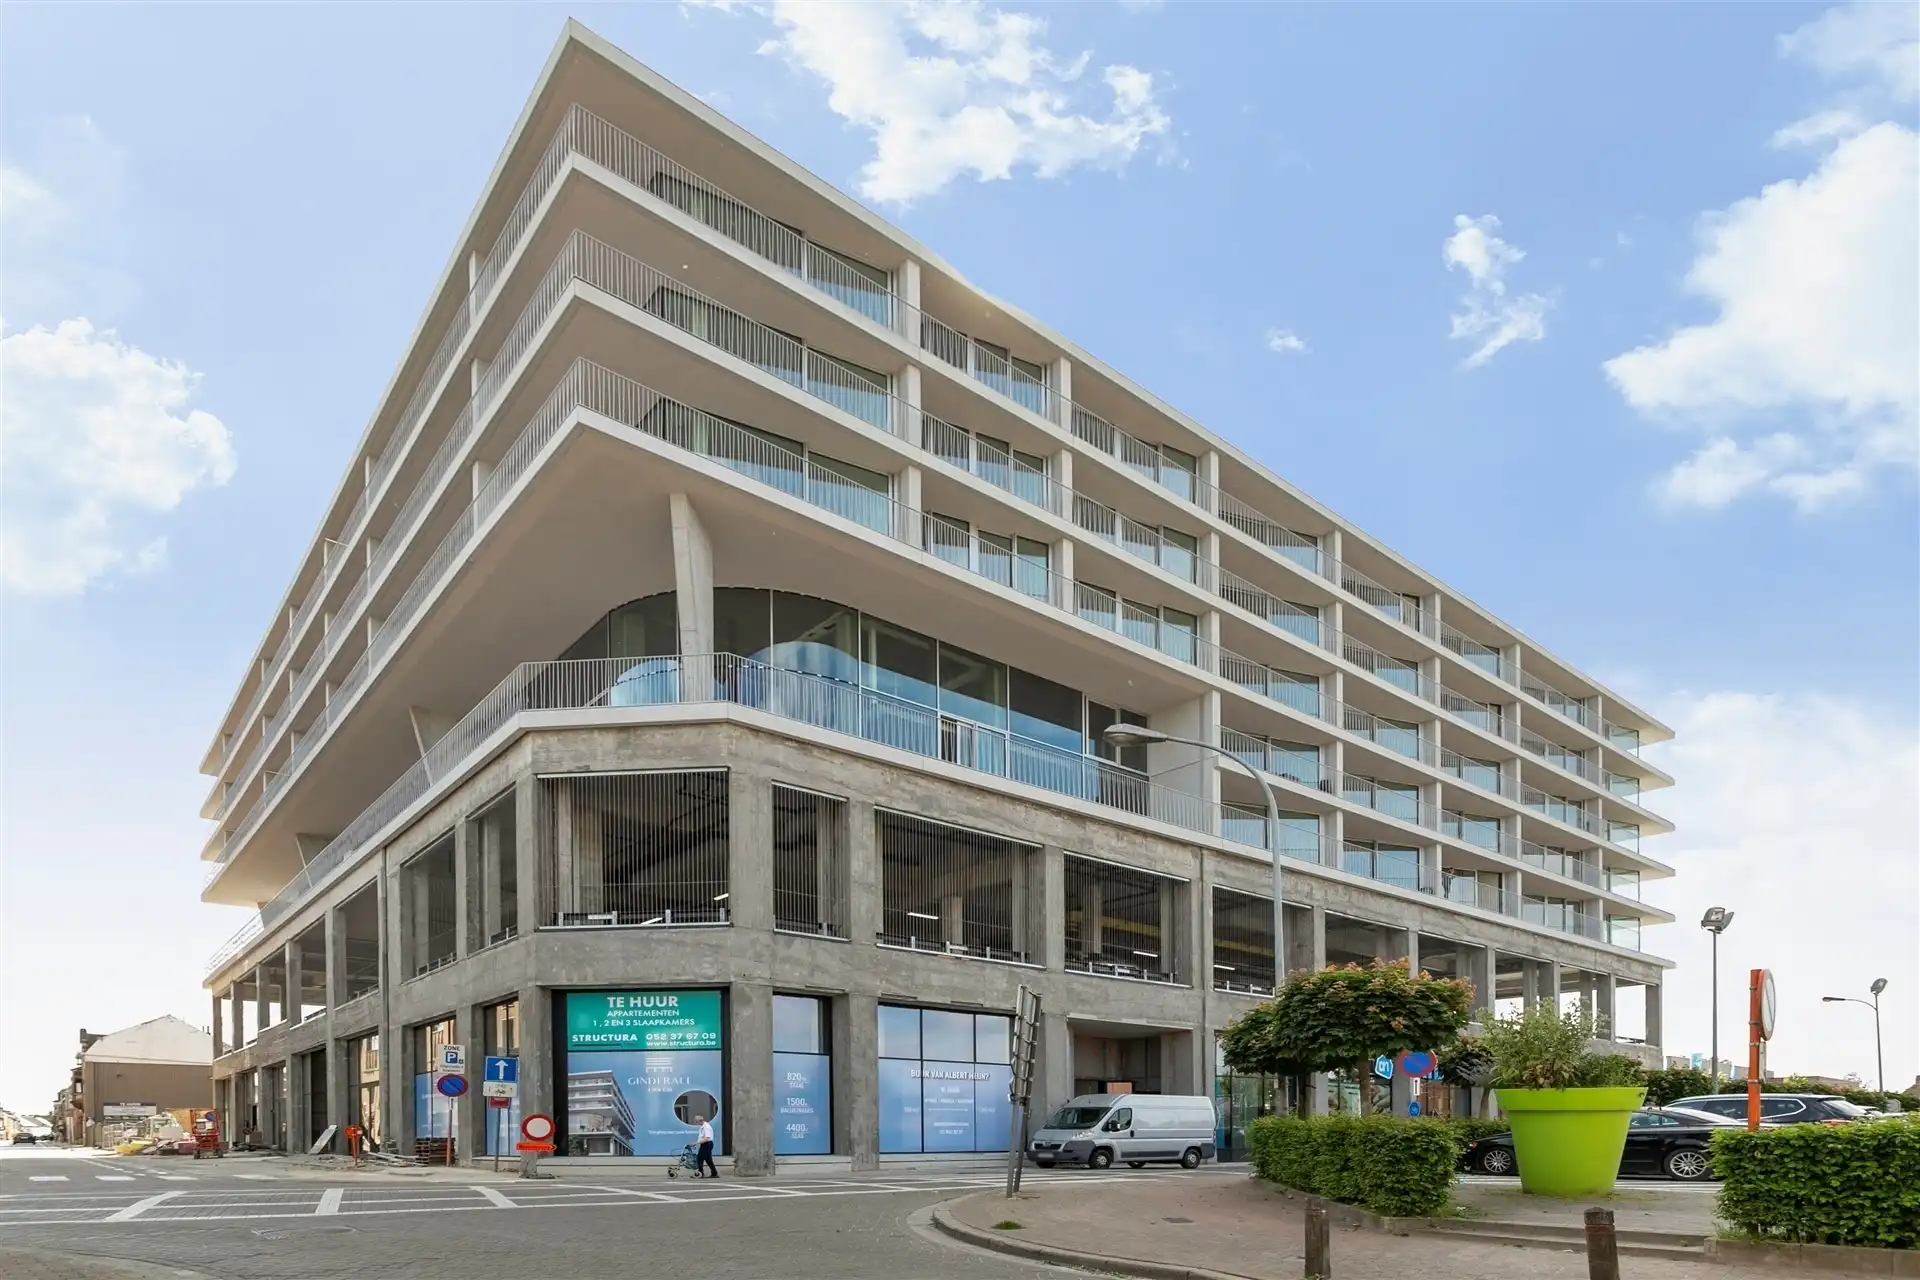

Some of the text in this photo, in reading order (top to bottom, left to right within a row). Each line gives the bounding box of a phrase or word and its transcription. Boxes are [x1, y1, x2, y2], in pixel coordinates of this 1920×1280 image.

[607, 996, 678, 1008] TE HUUR
[607, 1009, 680, 1017] APPARTEMENTEN
[625, 1019, 631, 1027] 3
[633, 1018, 695, 1026] SLAAPKAMERS
[572, 1034, 638, 1042] STRUCTURA
[447, 1053, 457, 1063] P
[786, 1072, 802, 1081] 820
[931, 1070, 944, 1079] VAN
[945, 1071, 968, 1079] ALBERT
